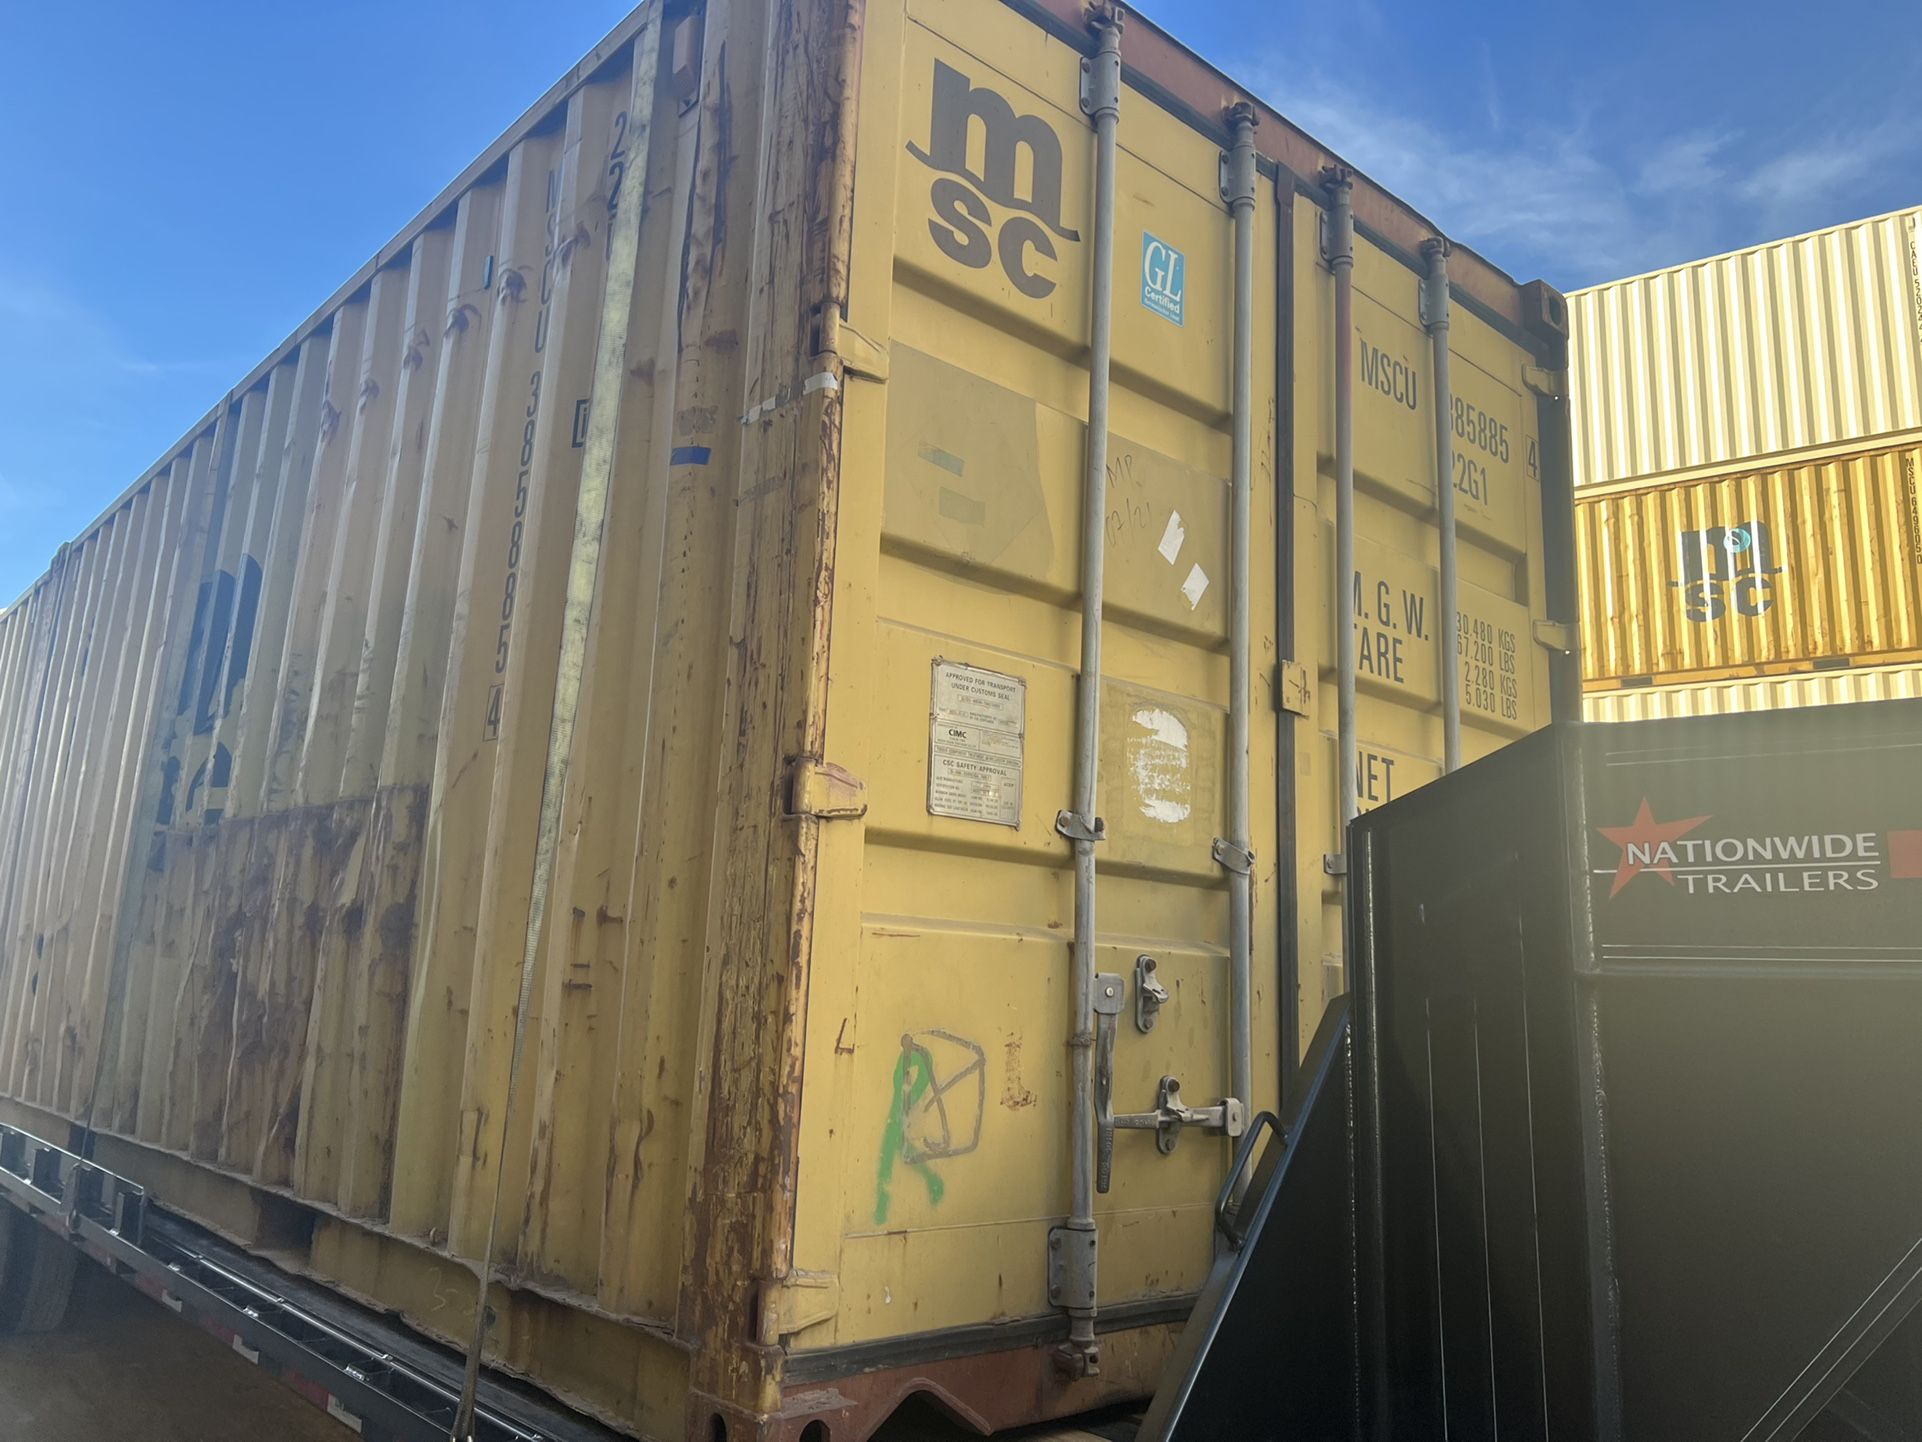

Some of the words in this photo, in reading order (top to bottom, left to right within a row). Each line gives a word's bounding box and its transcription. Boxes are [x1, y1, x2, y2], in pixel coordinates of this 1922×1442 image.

[1144, 241, 1182, 302] GL
[1910, 241, 1919, 276] CAEU
[1144, 286, 1180, 314] Certified
[1360, 338, 1417, 410] MSCU
[1450, 393, 1509, 464] 85885
[1528, 441, 1538, 478] 4
[1452, 450, 1488, 506] 2G1
[1906, 458, 1916, 494] MSCU
[495, 371, 542, 673] 385885
[1354, 623, 1404, 683] ARE
[1498, 628, 1515, 653] KGS
[1499, 651, 1515, 674] LBS
[946, 672, 973, 683] APPROVED
[975, 678, 985, 686] FOR
[987, 681, 1016, 693] TRANSPORT
[951, 683, 969, 692] UNDER
[971, 687, 996, 697] CUSTOMS
[998, 692, 1010, 700] SEAL
[1465, 661, 1494, 690] 2.280
[1500, 674, 1517, 699] KGS
[1466, 684, 1495, 713] 5.030
[1501, 696, 1517, 720] LBS
[948, 729, 967, 739] CIMC
[943, 759, 954, 767] CSC
[956, 761, 977, 771] SAFETY
[979, 766, 1007, 776] APPROVAL
[1626, 832, 1880, 865] NATIONWIDE
[1676, 869, 1880, 894] TRAILERS
